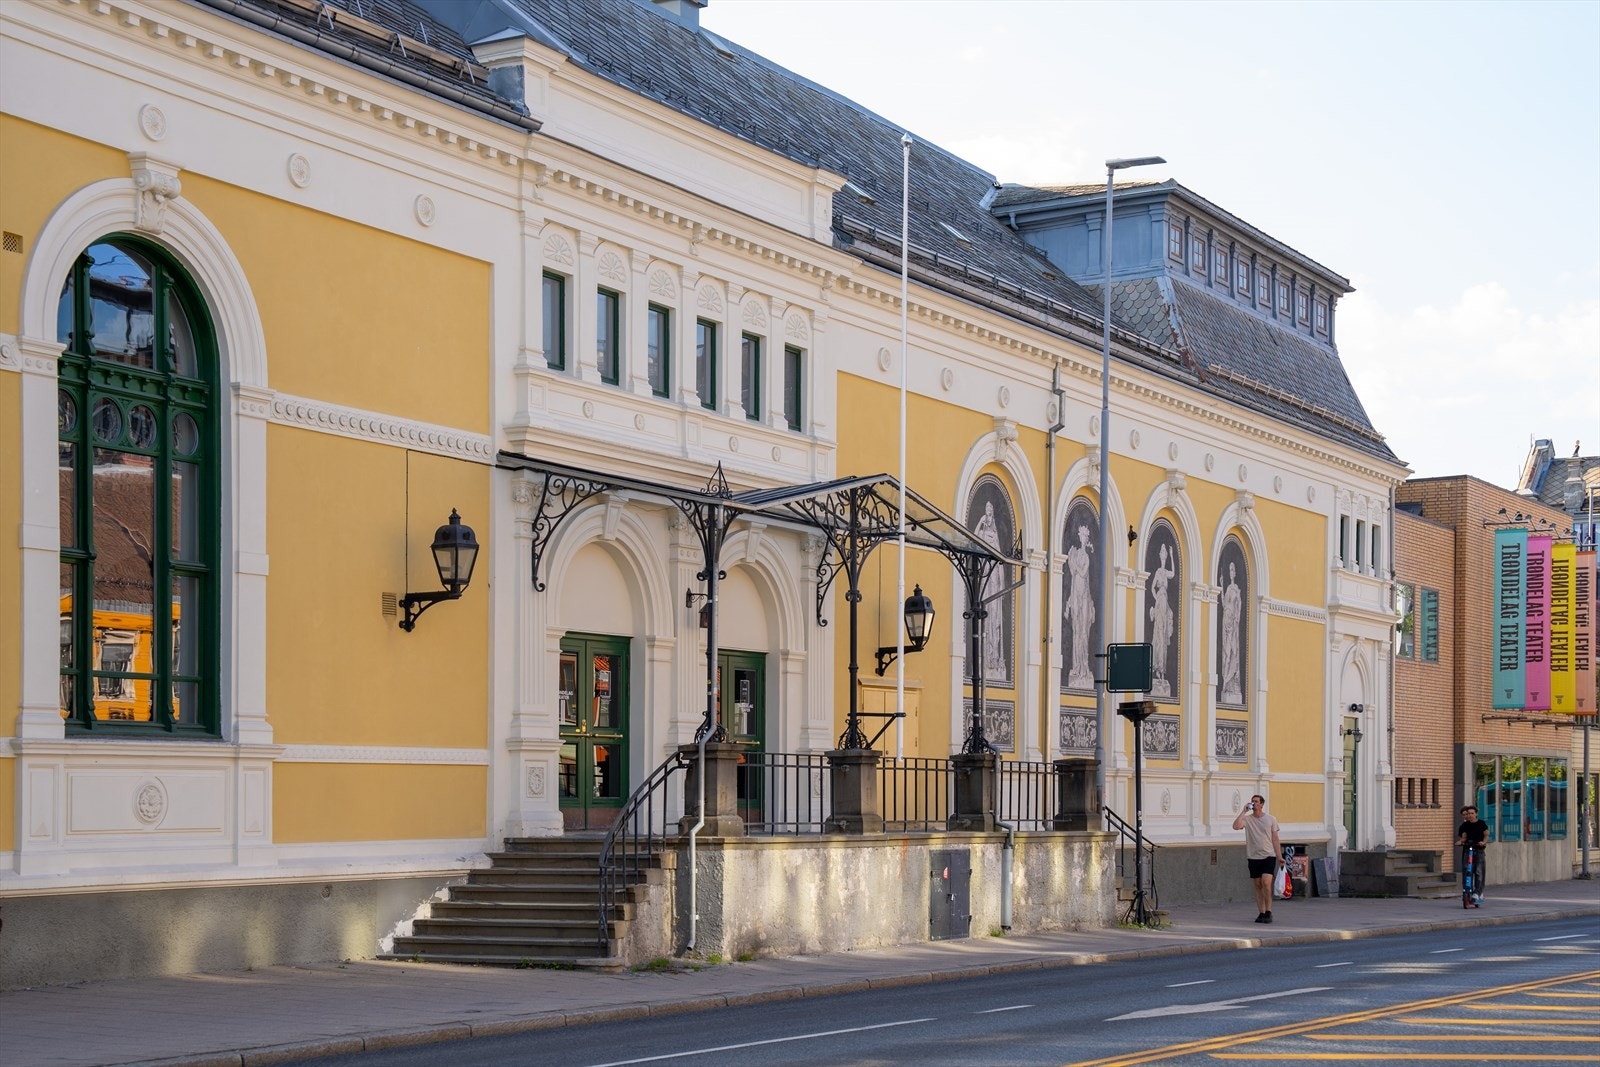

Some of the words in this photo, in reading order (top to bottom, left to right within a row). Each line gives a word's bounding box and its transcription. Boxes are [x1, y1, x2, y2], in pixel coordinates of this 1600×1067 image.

[1500, 543, 1520, 619] TRØNDELAG
[1526, 550, 1544, 618] TRØNDELAG
[1500, 623, 1518, 672] TEATER
[1525, 620, 1544, 663] TEATER
